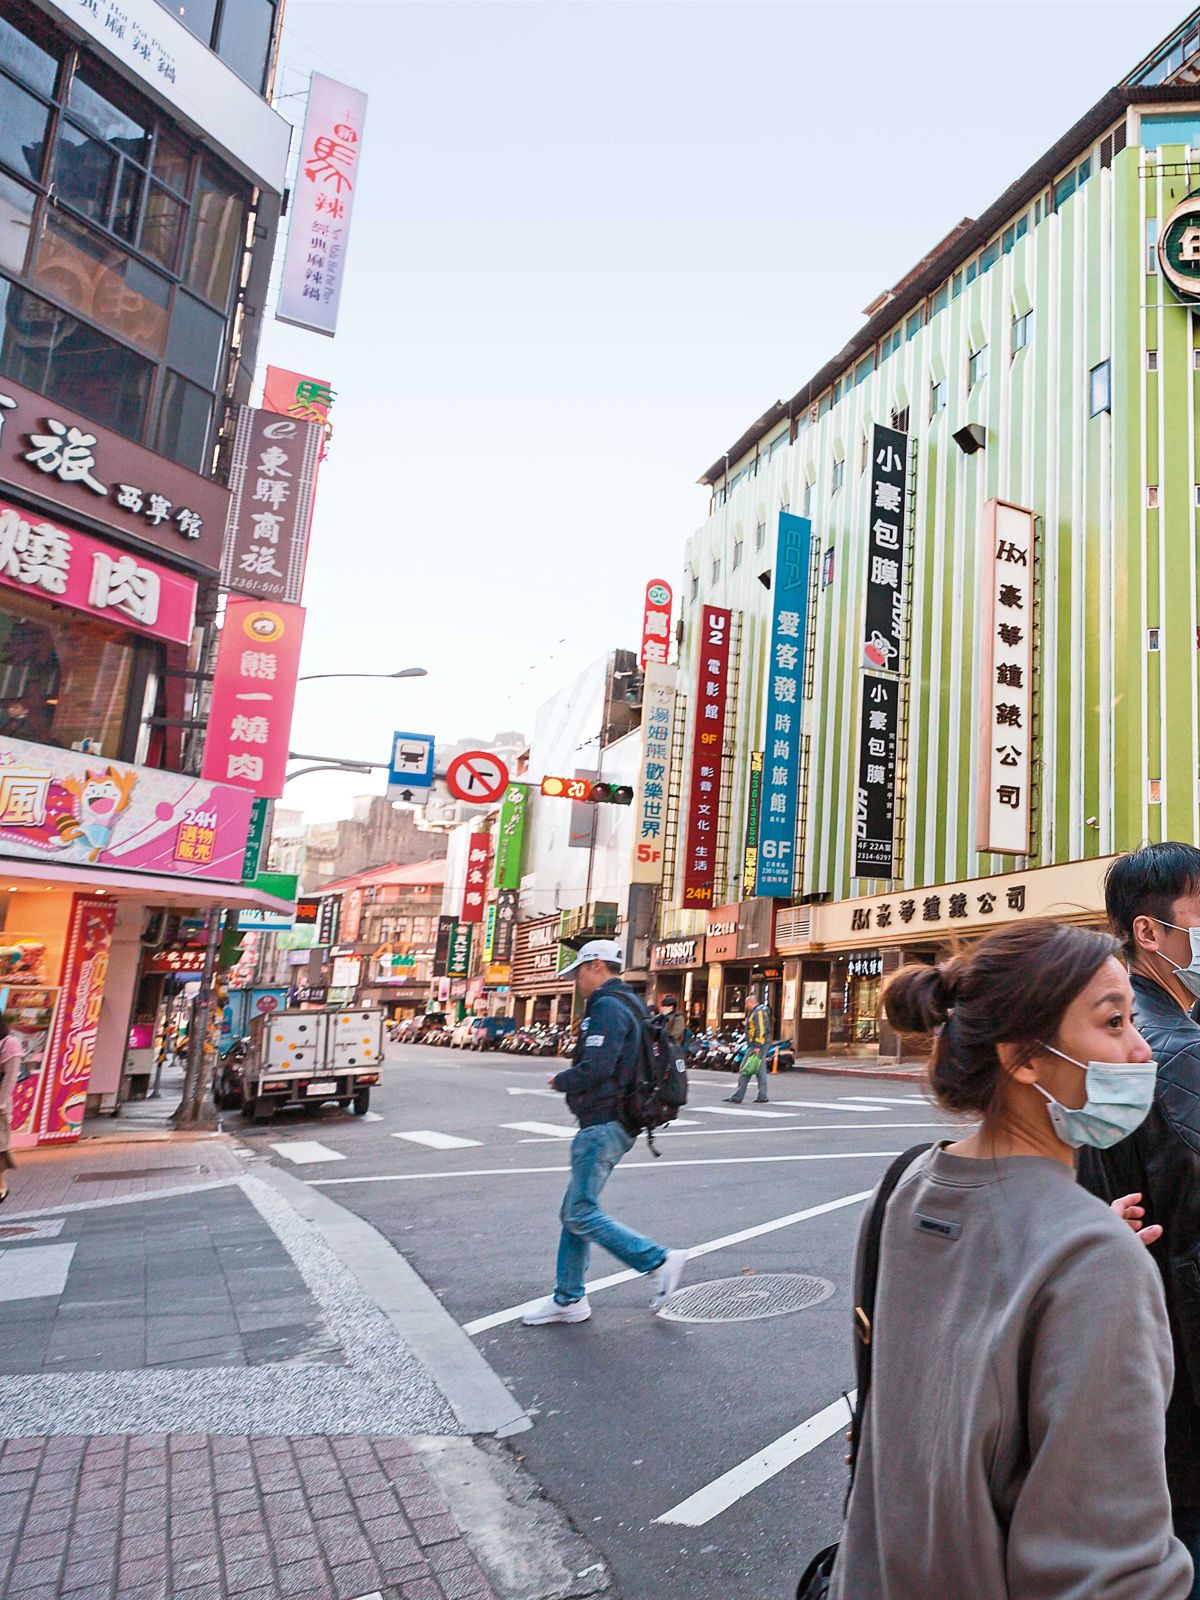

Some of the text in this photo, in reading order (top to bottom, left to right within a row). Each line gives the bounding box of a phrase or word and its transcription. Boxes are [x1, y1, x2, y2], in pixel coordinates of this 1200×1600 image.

[239, 445, 293, 577] 東驛商旅
[870, 446, 902, 588] 小豪包膜
[231, 577, 286, 595] 2361-5161
[708, 614, 725, 646] U2
[705, 659, 721, 720] 電影館
[995, 584, 1024, 809] 豪華鐘錶公司
[226, 650, 277, 782] 熊一燒肉
[700, 733, 717, 745] 9F
[866, 684, 888, 784] 小豪包膜
[641, 706, 670, 839] 湯姆熊歡樂世界
[567, 781, 585, 797] 20
[184, 810, 217, 828] 24H
[637, 845, 661, 863] 5F
[762, 840, 791, 859] 6F
[686, 887, 712, 901] 24H
